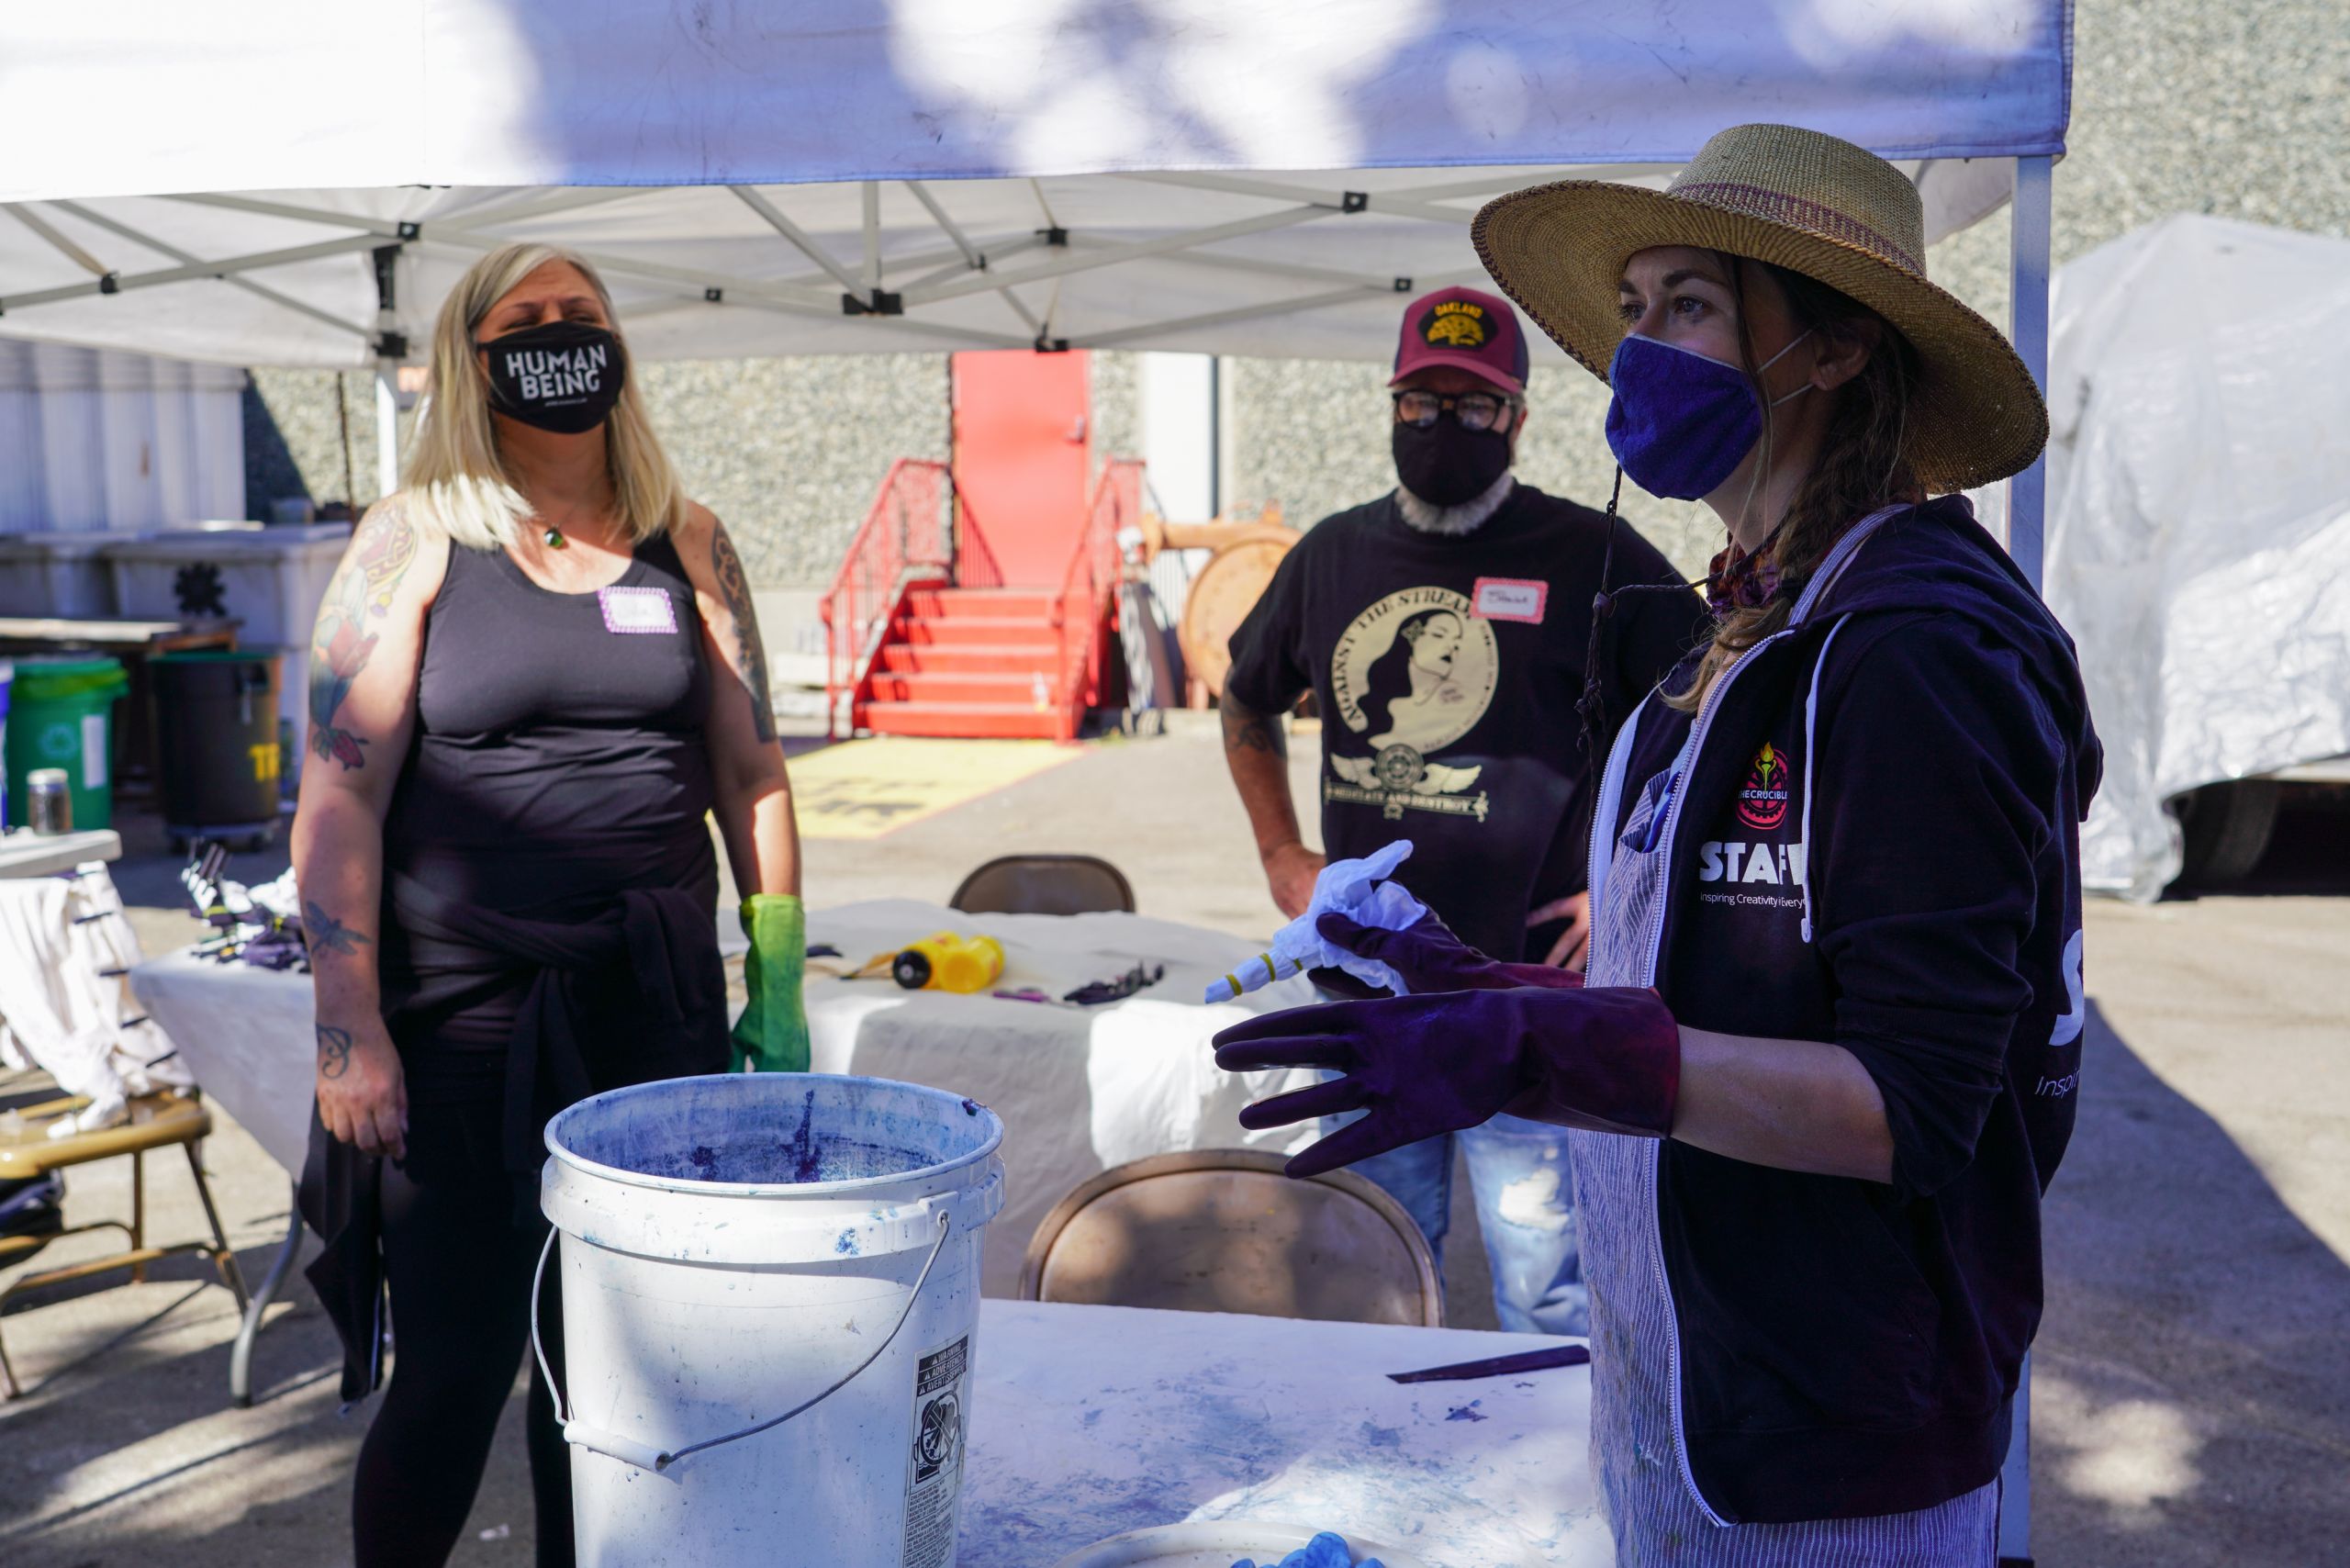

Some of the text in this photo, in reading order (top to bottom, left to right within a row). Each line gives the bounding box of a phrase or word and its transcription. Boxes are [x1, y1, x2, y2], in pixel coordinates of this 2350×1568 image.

[506, 343, 608, 378] HUMAN
[521, 369, 600, 400] BEING
[1335, 636, 1362, 722] AGAINST
[1357, 601, 1394, 629] THE
[1397, 588, 1472, 621] STREA
[1700, 891, 1735, 906] Inspiring
[1736, 893, 1778, 908] Creativity
[938, 1342, 962, 1363] WARNING
